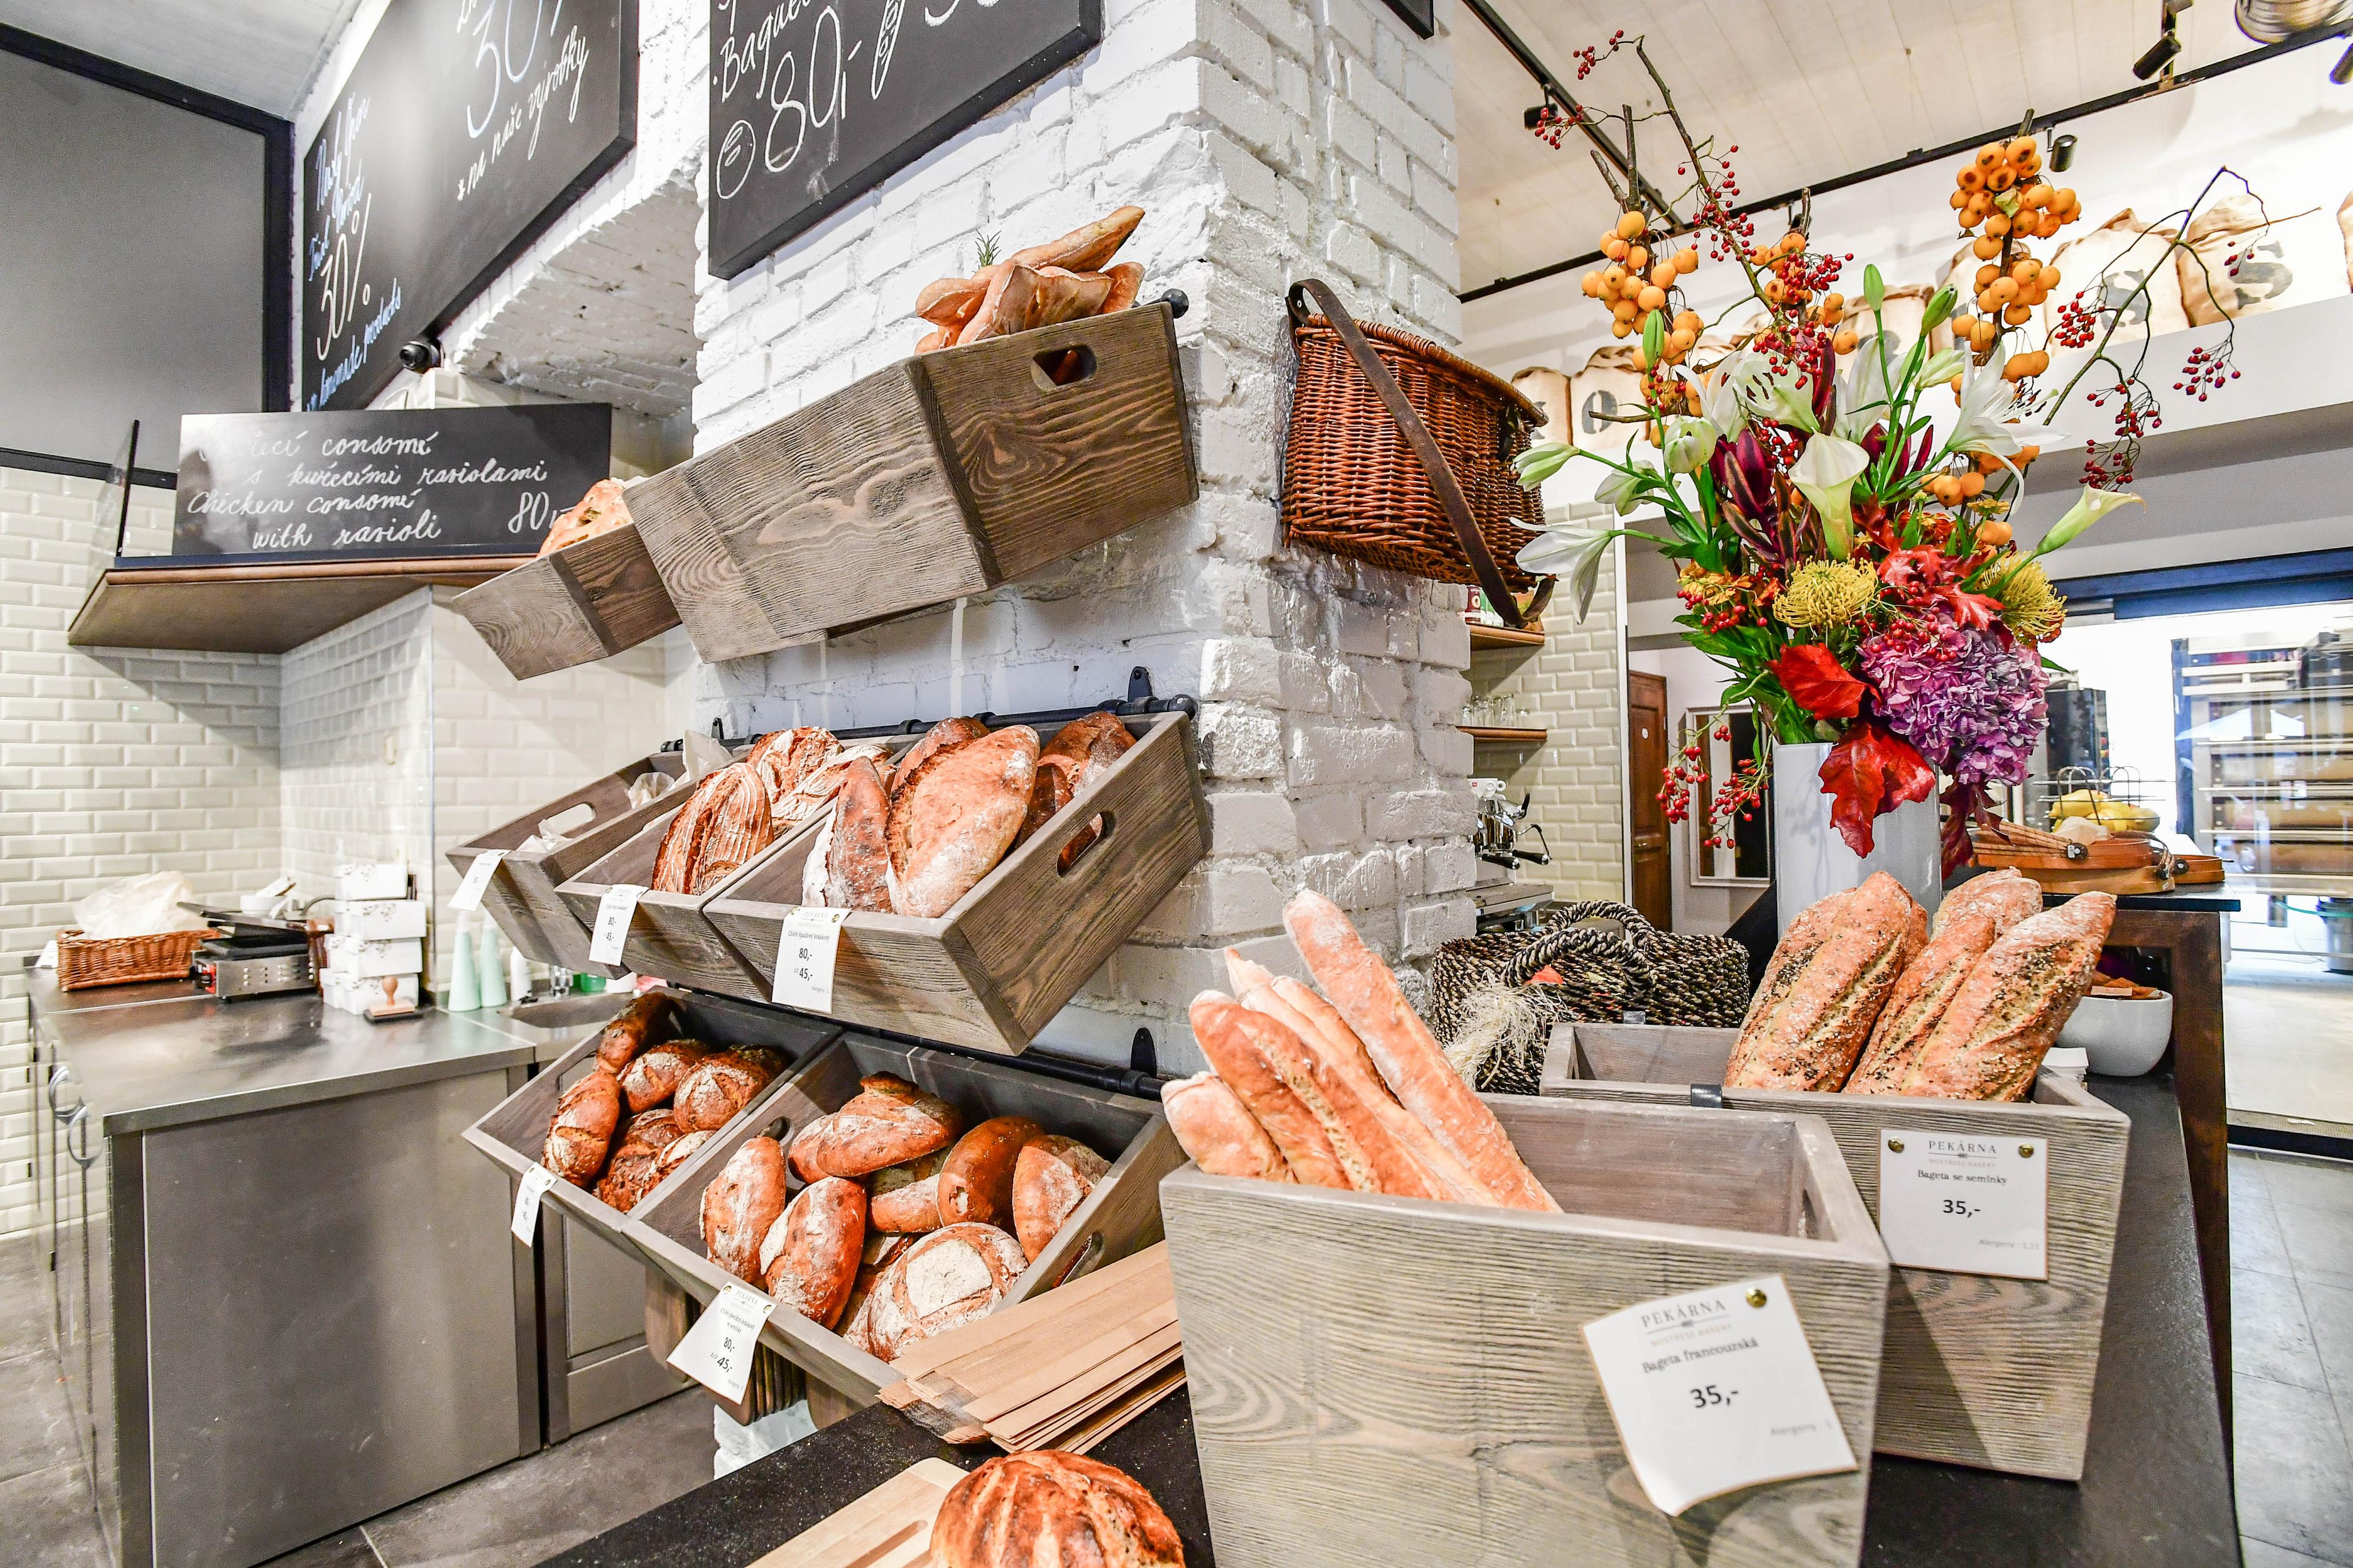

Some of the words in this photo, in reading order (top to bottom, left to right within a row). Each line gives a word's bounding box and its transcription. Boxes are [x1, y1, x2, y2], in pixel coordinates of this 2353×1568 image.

[492, 102, 522, 164] naše
[528, 25, 589, 161] výrobky
[316, 193, 370, 361] 30%
[321, 431, 439, 456] consomé
[242, 469, 263, 485] s
[417, 458, 547, 485] raviolami
[187, 487, 294, 515] Chicken
[306, 489, 422, 514] consomé
[253, 523, 312, 549] with
[332, 509, 442, 546] ravioli
[799, 948, 812, 961] 80,-
[799, 967, 813, 982] 45,-
[1928, 1140, 1997, 1153] PEKÁRNA
[1918, 1169, 1949, 1180] Bageta
[1942, 1199, 1981, 1218] 35,-
[1640, 1299, 1726, 1328] PEKÁRNA
[724, 1337, 735, 1352] 80,-
[1642, 1355, 1681, 1374] Bageta
[1683, 1336, 1759, 1362] francouzská
[717, 1357, 732, 1373] 45,-
[1689, 1384, 1739, 1409] 35,-
